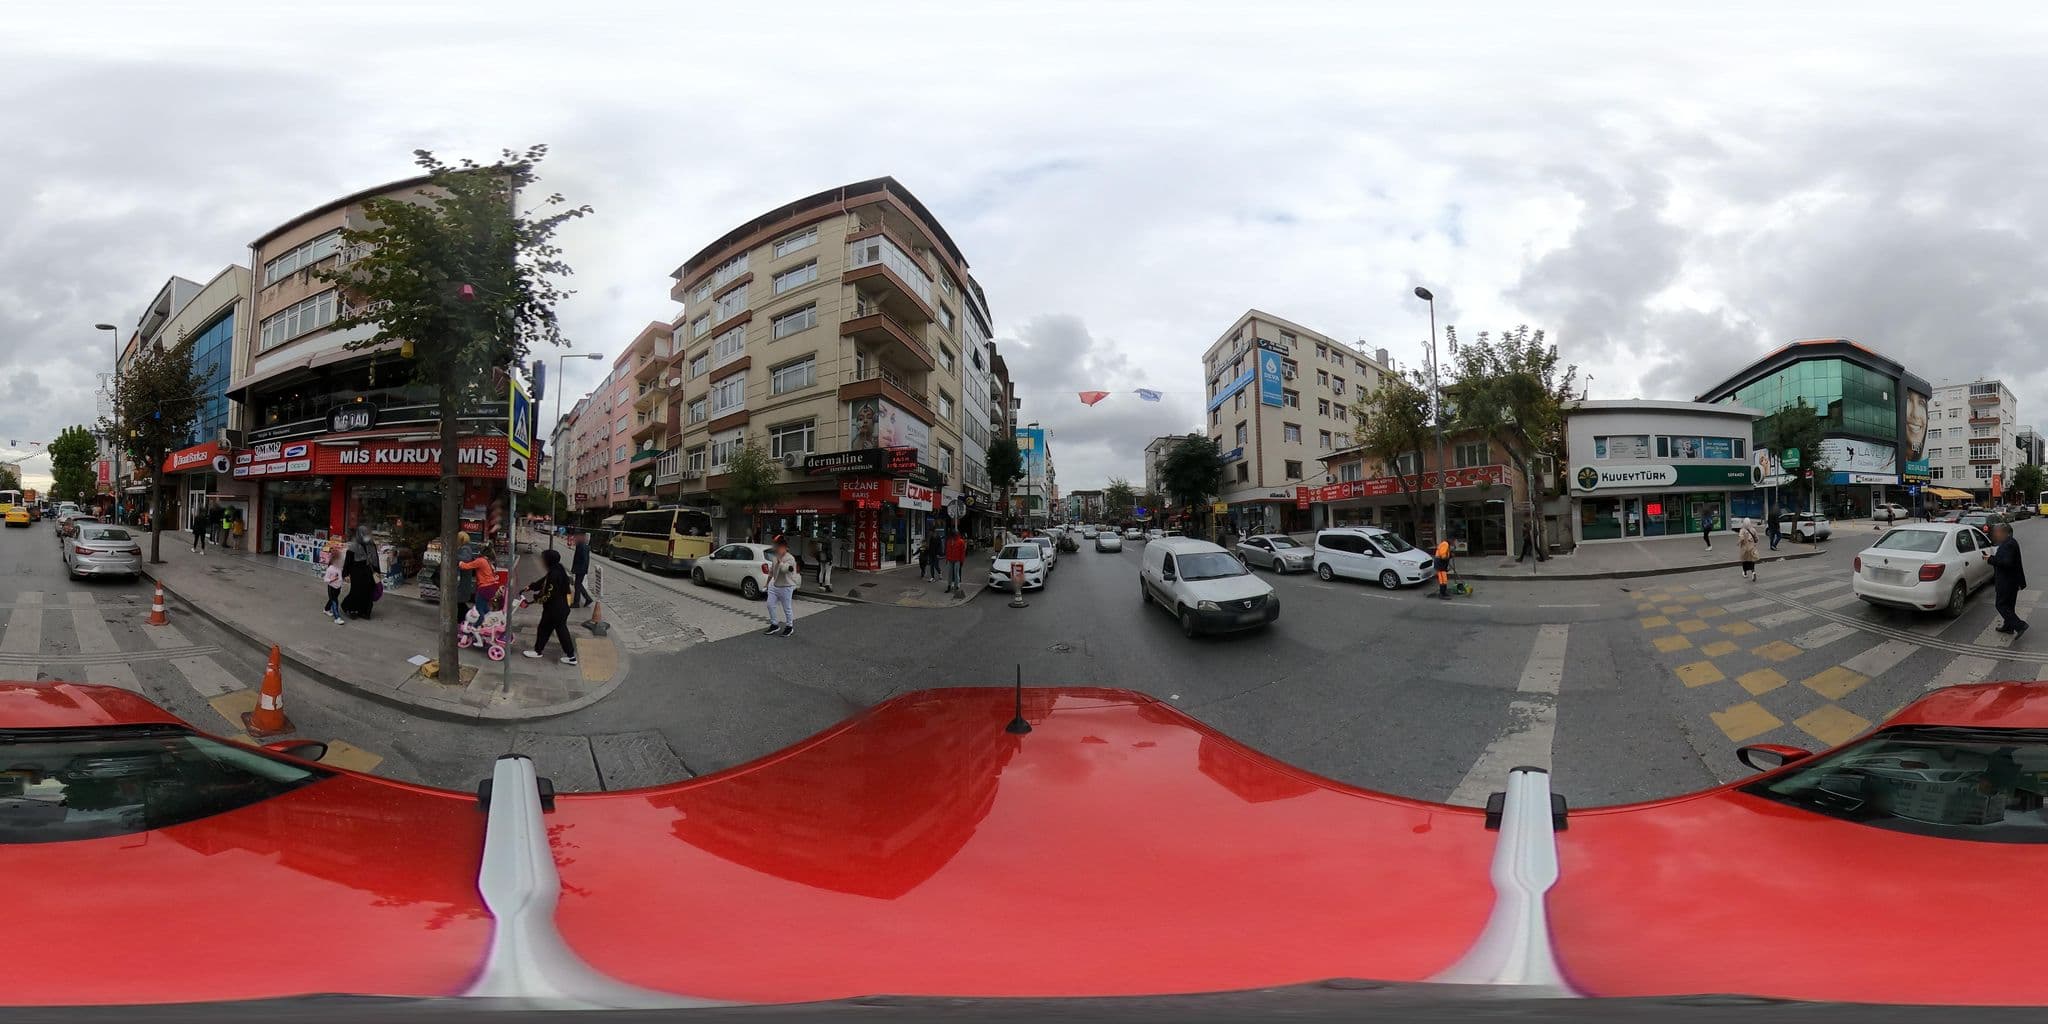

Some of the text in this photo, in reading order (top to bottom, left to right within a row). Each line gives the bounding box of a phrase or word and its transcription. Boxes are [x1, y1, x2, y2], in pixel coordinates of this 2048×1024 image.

[340, 445, 498, 469] MİS KURUYMİŞ
[808, 453, 864, 468] dermaline
[842, 482, 878, 490] ECZANE
